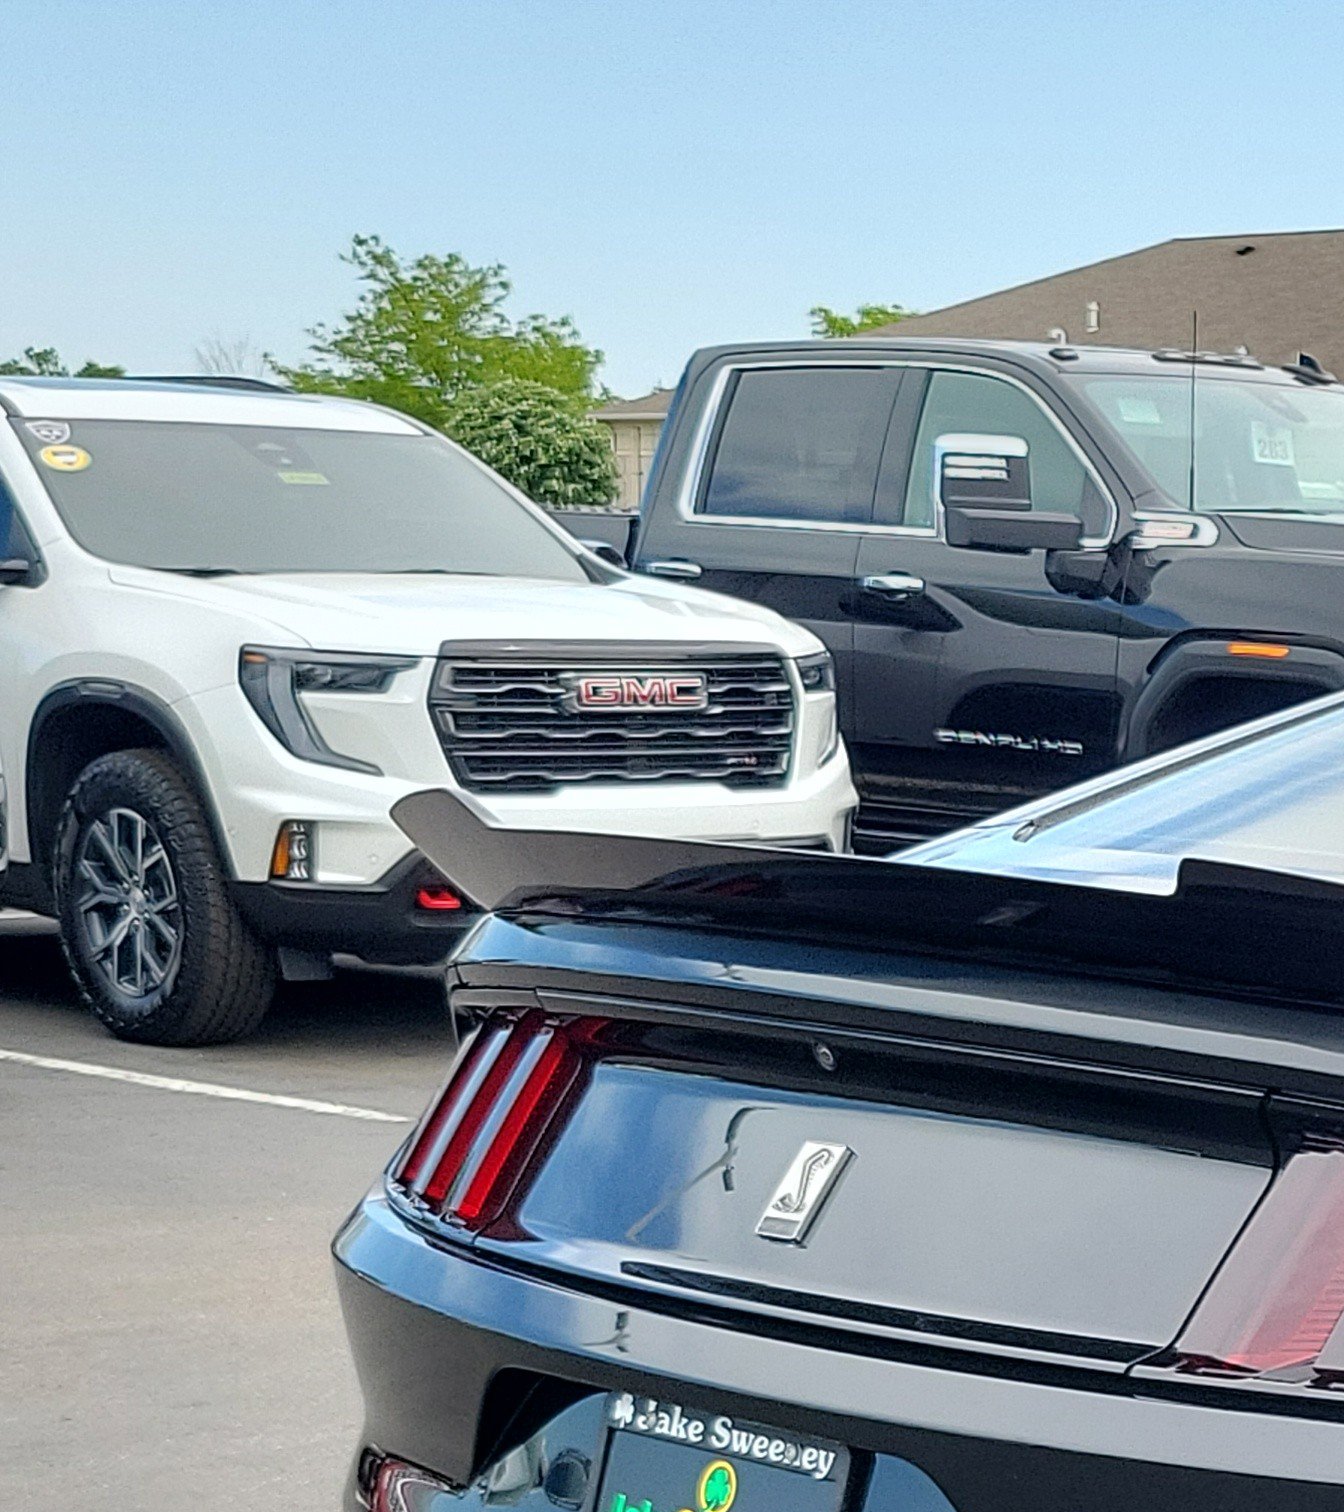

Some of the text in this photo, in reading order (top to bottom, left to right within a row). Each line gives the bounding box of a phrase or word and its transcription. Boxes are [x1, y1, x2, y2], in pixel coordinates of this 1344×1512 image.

[579, 677, 702, 705] GMC
[933, 728, 1039, 751] DENALI
[636, 1399, 837, 1480] Jake Sweeney
